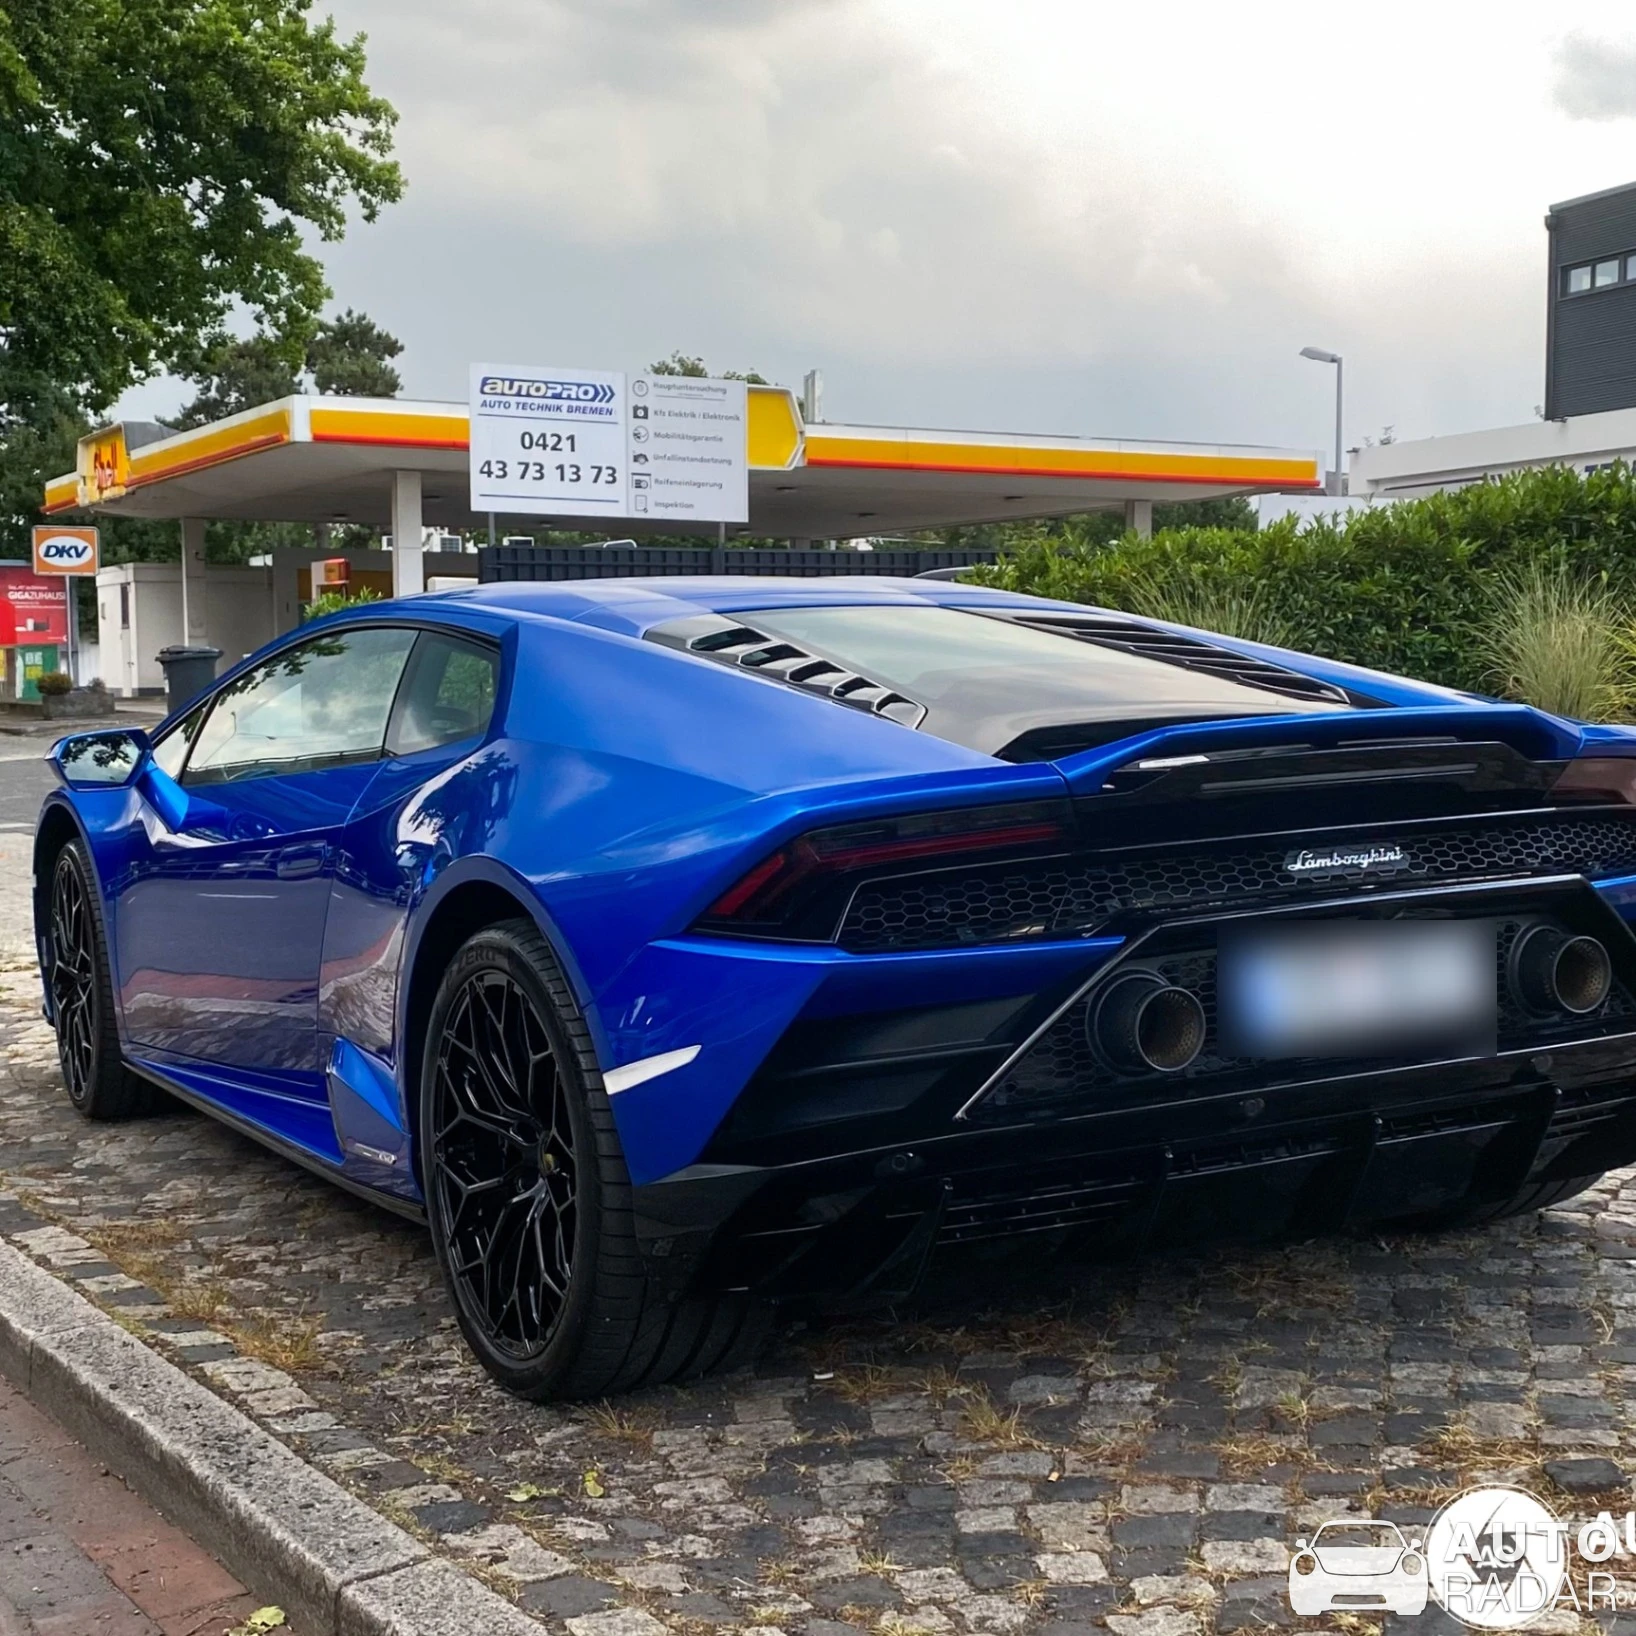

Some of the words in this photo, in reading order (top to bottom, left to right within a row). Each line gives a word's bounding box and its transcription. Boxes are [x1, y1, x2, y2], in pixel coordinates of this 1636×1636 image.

[653, 382, 728, 395] Hauptuntersuchung
[480, 399, 511, 410] AUTO
[515, 401, 563, 413] TECHNIK
[566, 404, 613, 416] BREMEN
[654, 409, 666, 417] Kfz
[668, 410, 696, 419] Elektrik
[702, 412, 740, 421] Elektronik
[520, 431, 576, 452] 0421
[653, 431, 723, 442] Mobilitätsgarantie
[479, 460, 508, 479] 43
[517, 461, 545, 481] 73
[555, 463, 581, 482] 13
[590, 465, 617, 484] 73
[654, 478, 723, 490] Reifeneinlagerung
[654, 501, 694, 509] Inspektion
[43, 544, 89, 558] DKV
[8, 591, 66, 600] GIGAZUHAUS
[1287, 847, 1403, 871] Lamborghini
